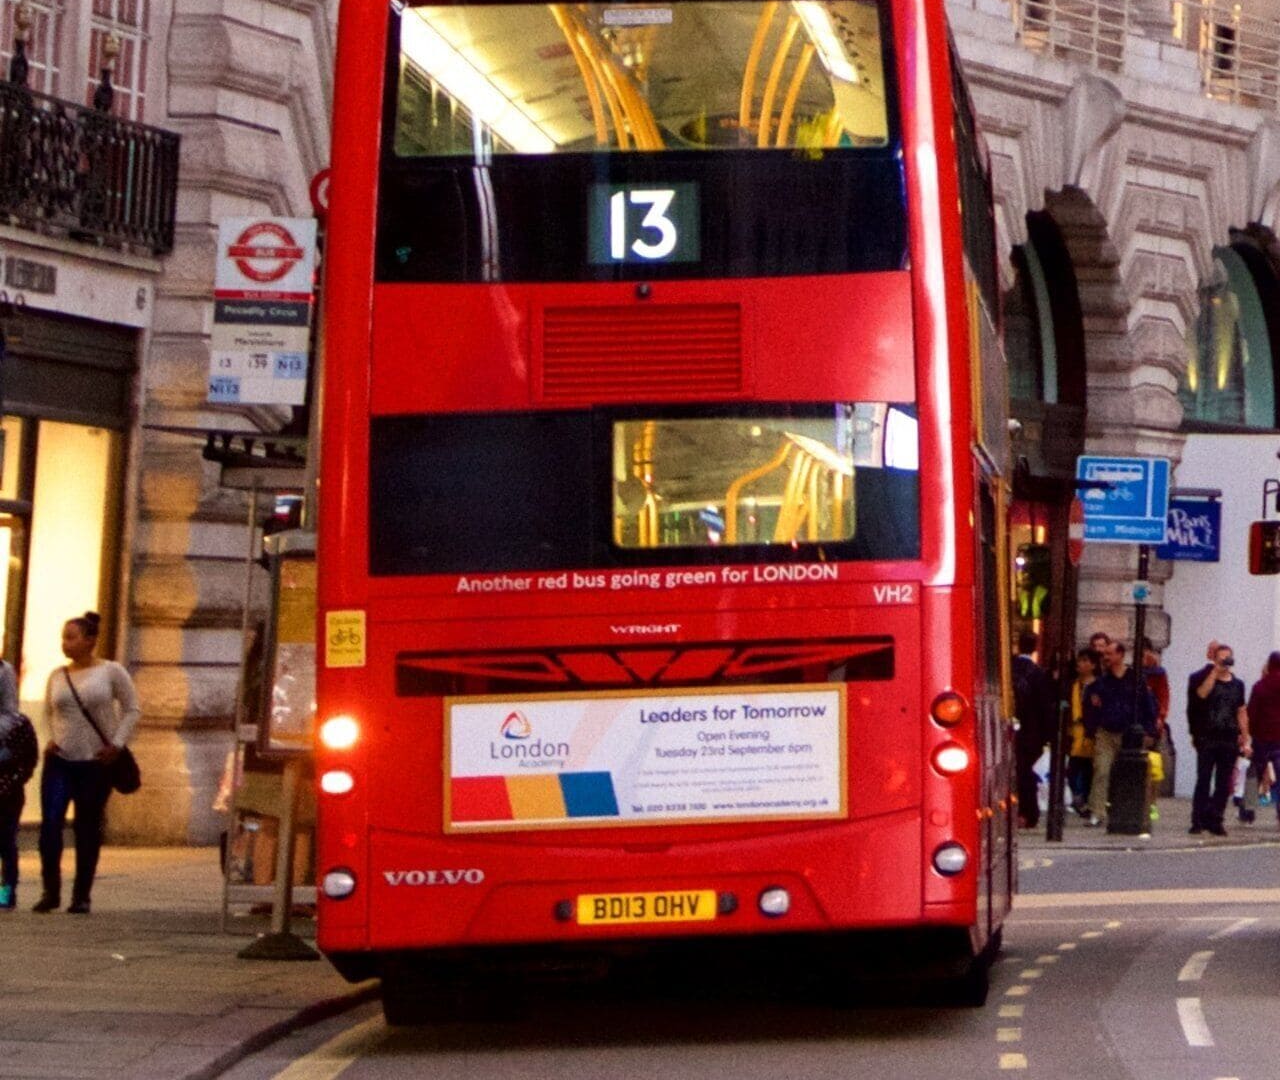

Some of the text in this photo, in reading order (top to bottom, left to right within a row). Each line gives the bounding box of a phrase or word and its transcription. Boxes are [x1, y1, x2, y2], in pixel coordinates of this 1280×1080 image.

[610, 189, 677, 259] 13
[219, 358, 232, 368] 13
[457, 563, 839, 593] Another red bus going green for LONDON
[873, 584, 913, 604] VH2
[640, 704, 827, 724] Leaders for Tomorrow
[697, 729, 770, 743] Open Evening
[490, 738, 570, 760] London
[655, 747, 698, 759] Tuesday
[728, 744, 784, 756] September
[518, 759, 565, 769] Academy
[383, 868, 485, 886] VOLVO
[593, 894, 700, 919] BD13 OHV
